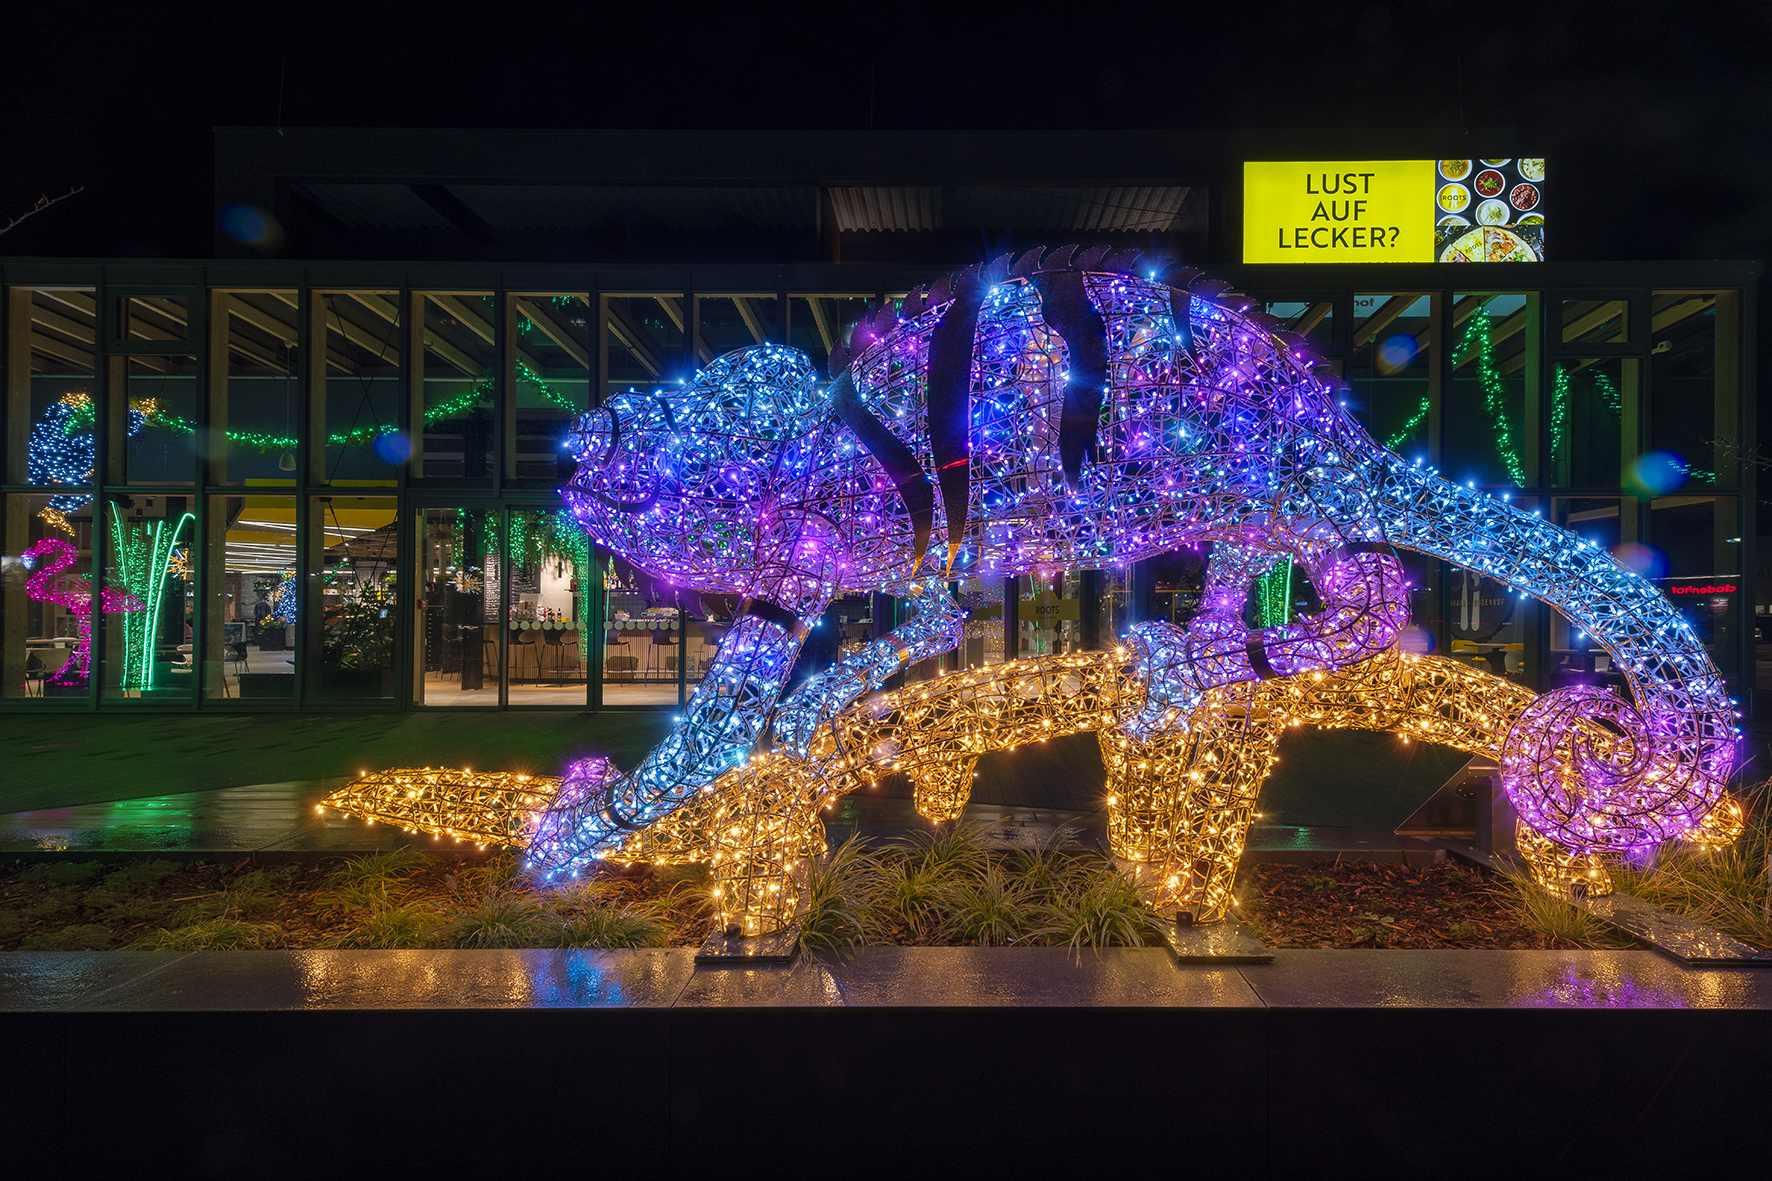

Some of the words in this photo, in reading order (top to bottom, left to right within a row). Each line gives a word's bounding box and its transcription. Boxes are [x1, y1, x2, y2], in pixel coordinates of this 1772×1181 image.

[1306, 173, 1375, 195] LUST
[1311, 200, 1367, 222] AUF
[1278, 226, 1400, 249] LECKER?
[1464, 241, 1483, 254] ROOTS
[1036, 605, 1060, 614] ROOTS
